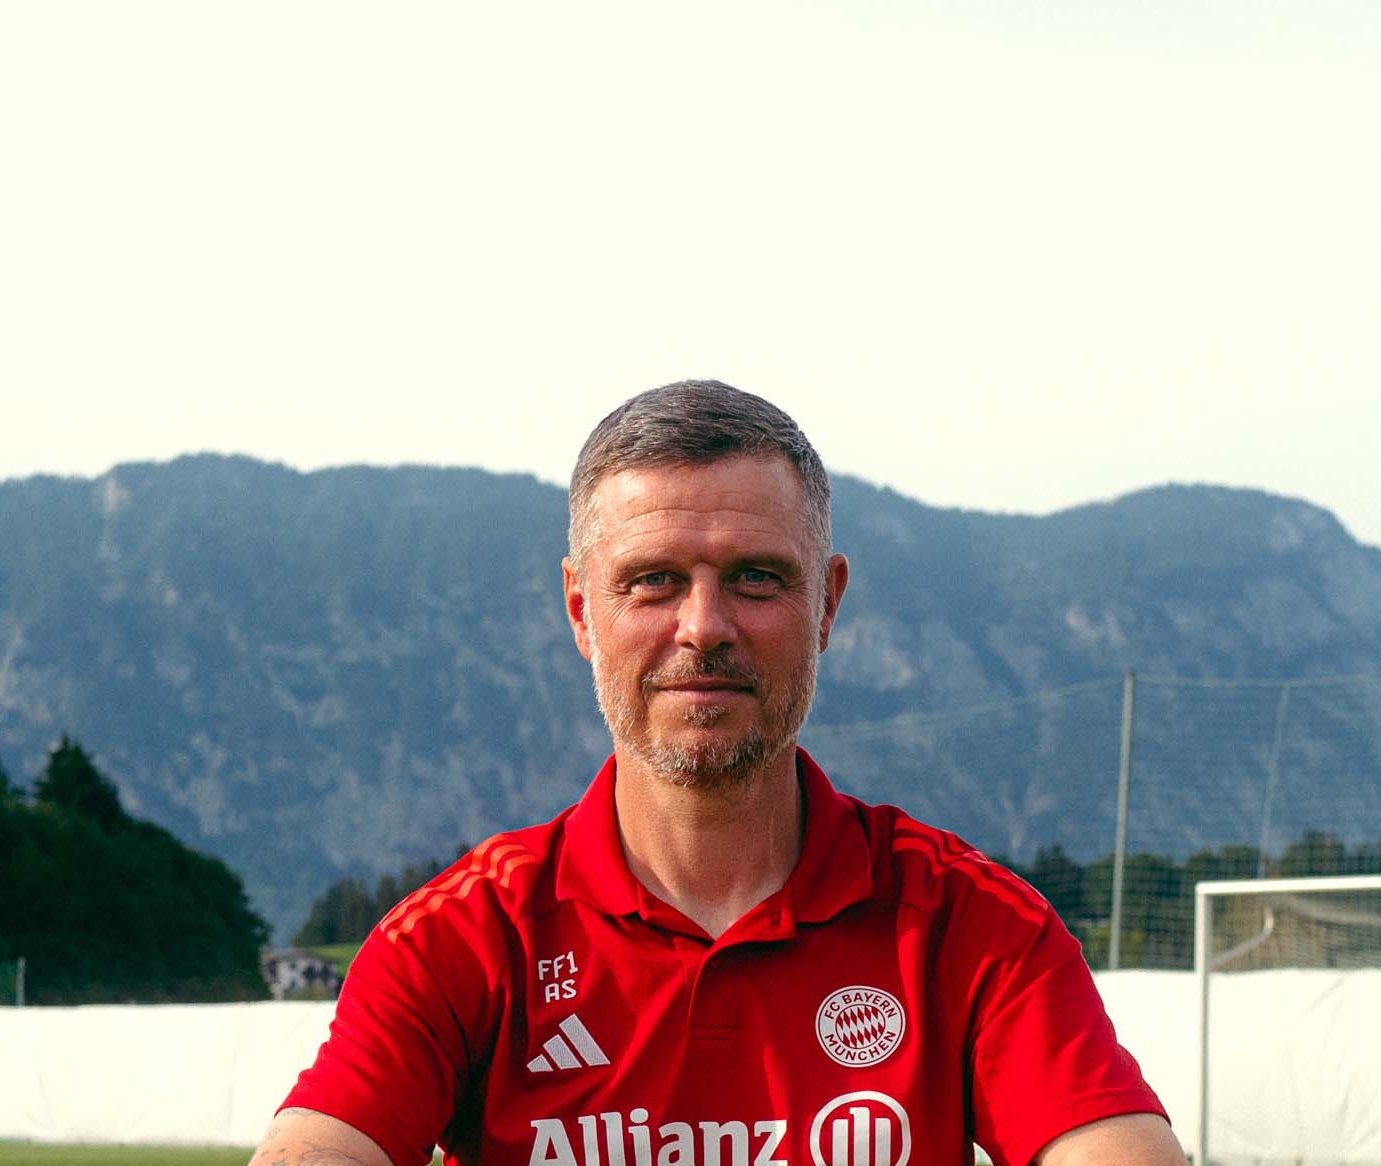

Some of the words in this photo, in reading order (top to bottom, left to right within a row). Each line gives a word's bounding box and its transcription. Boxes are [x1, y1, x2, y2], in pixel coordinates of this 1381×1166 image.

[538, 951, 578, 980] FF1
[545, 979, 577, 1003] AS
[824, 1001, 840, 1020] FC
[842, 992, 897, 1018] BAYERN
